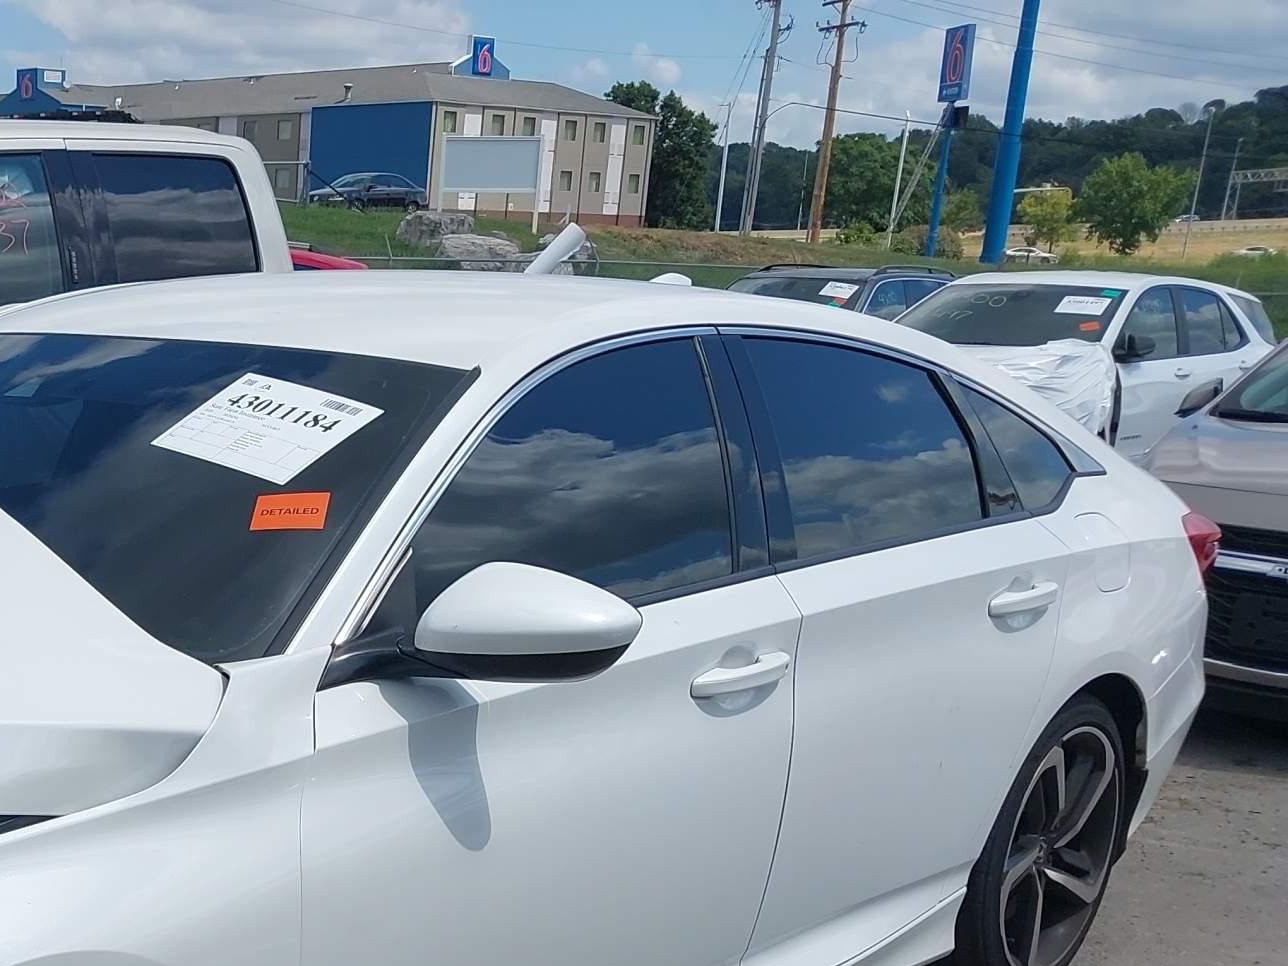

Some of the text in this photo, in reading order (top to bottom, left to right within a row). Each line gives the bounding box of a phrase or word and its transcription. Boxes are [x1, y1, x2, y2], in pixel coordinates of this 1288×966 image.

[478, 43, 492, 73] 6
[946, 28, 965, 84] 6
[20, 74, 33, 98] 6
[227, 393, 342, 433] 43011184
[260, 507, 320, 516] DETAILED
